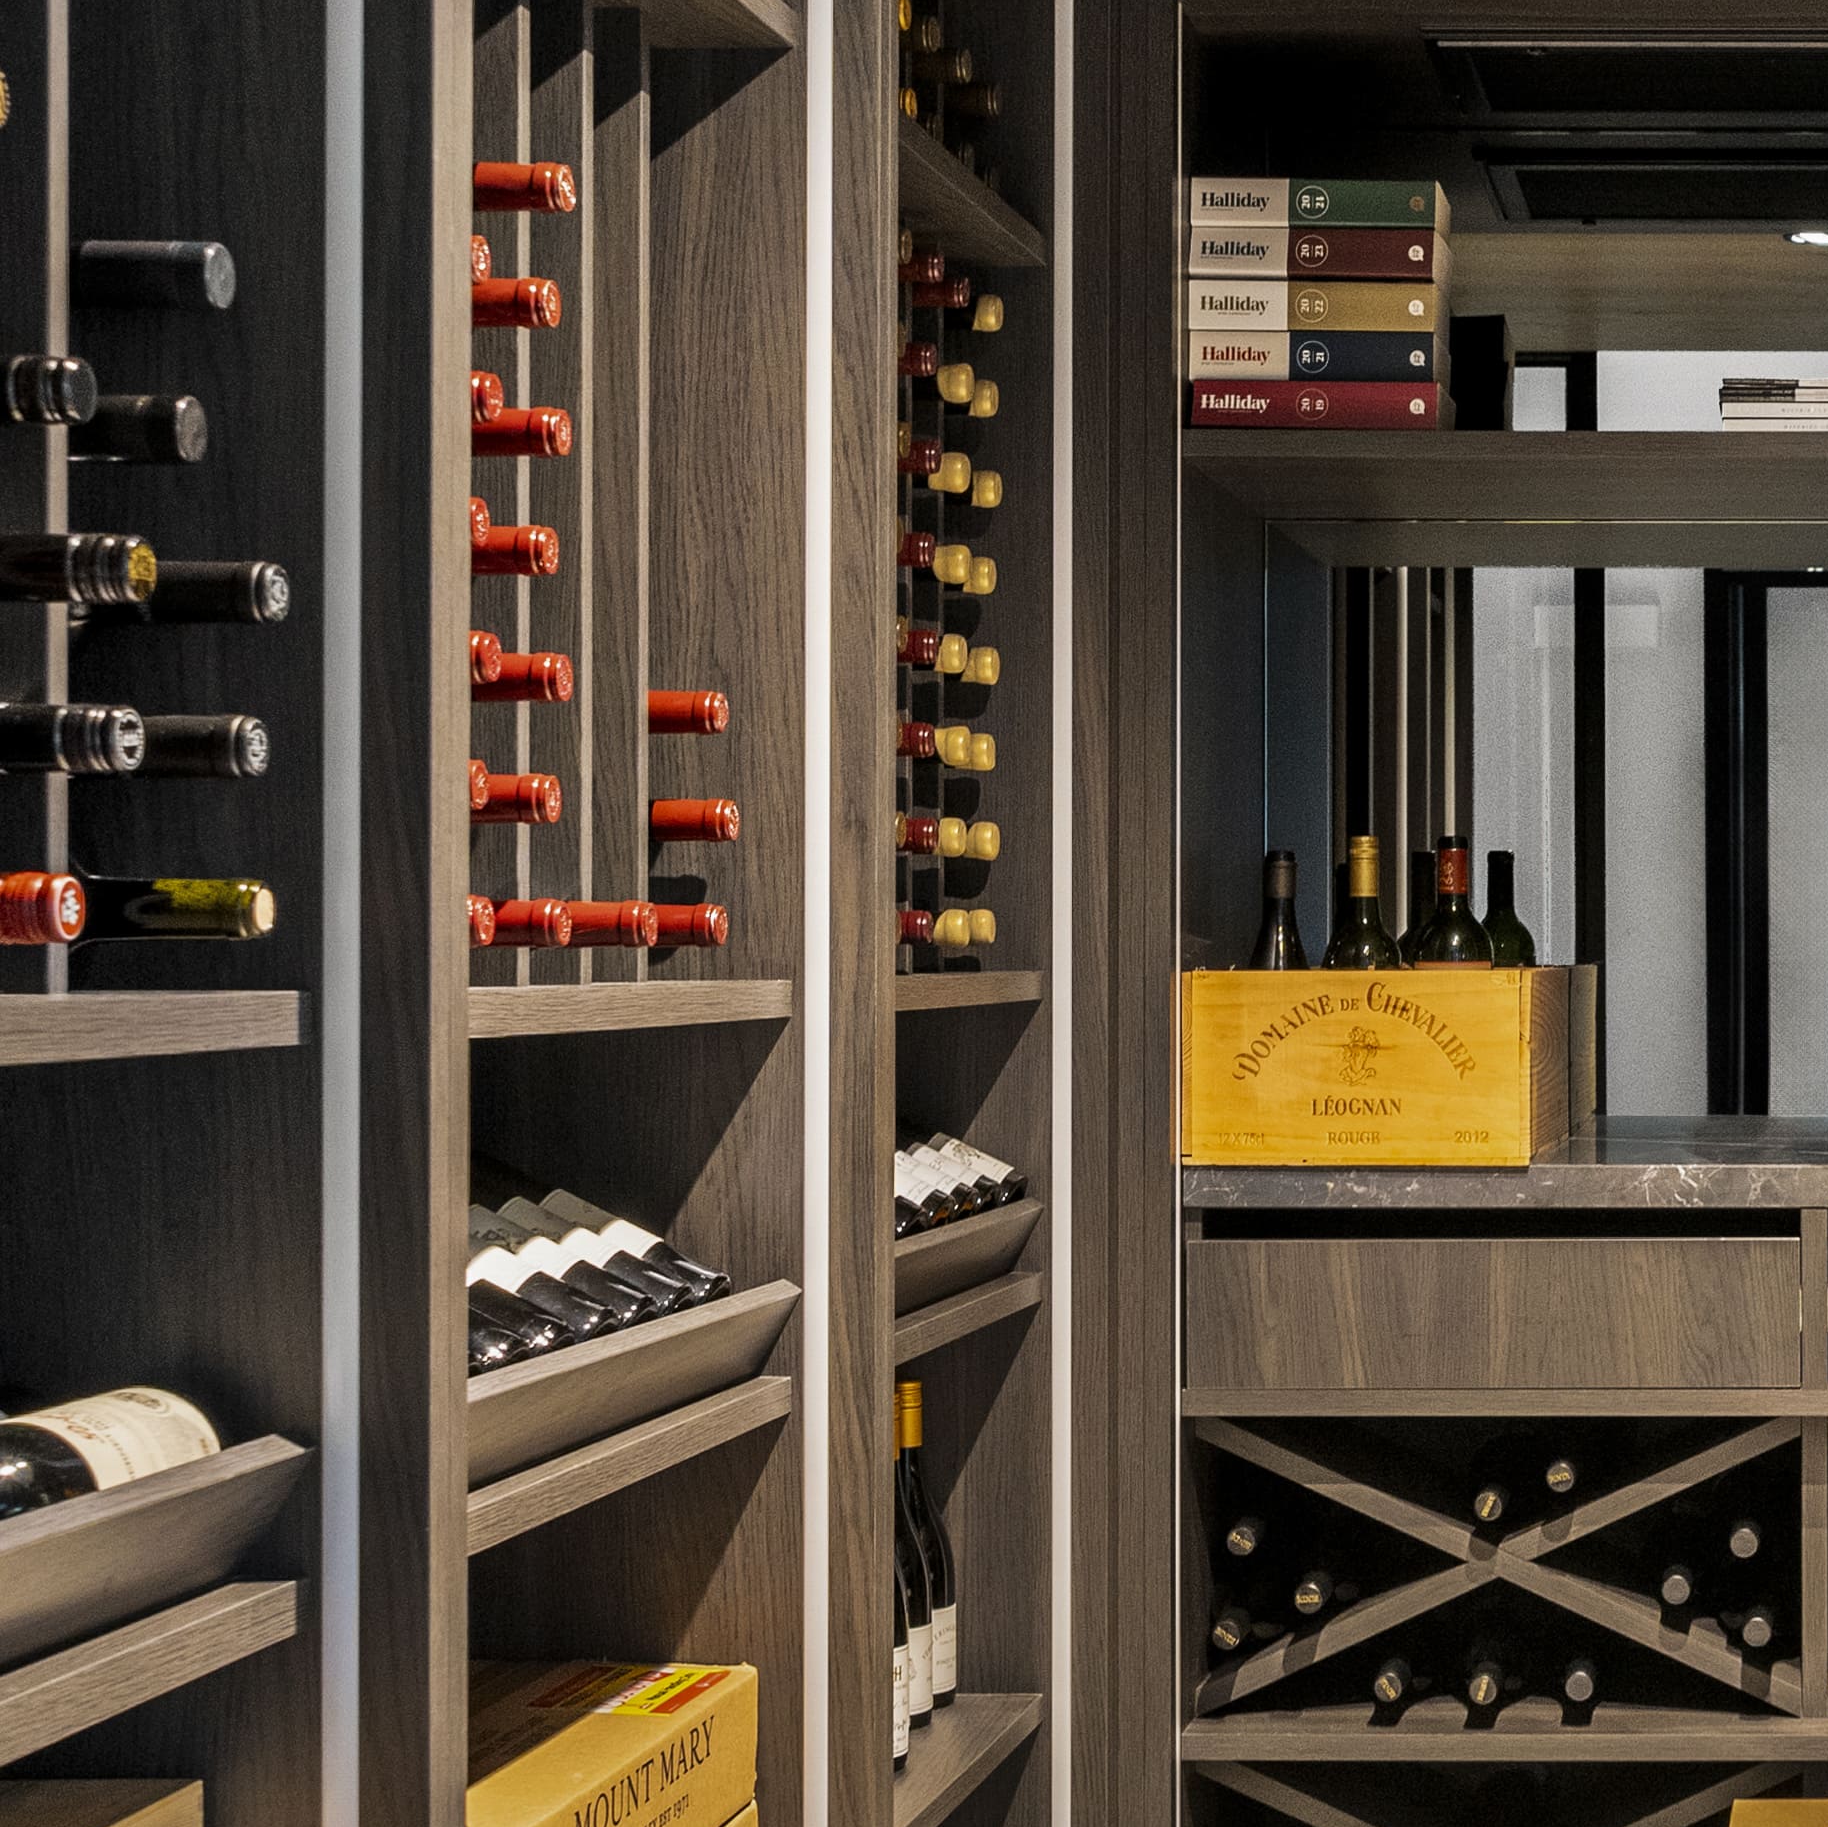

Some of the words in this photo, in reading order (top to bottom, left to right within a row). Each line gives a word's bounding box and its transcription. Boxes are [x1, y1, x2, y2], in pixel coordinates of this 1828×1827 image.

[1200, 192, 1270, 212] Halliday
[1301, 194, 1311, 209] 20
[1200, 241, 1270, 260] Halliday
[1301, 244, 1310, 258] 20
[1314, 244, 1325, 258] 23
[1200, 295, 1269, 315] Halliday
[1301, 298, 1310, 313] 20
[1314, 299, 1325, 313] 22
[1201, 346, 1270, 365] Halliday
[1302, 349, 1311, 364] 20
[1315, 351, 1326, 364] 21
[1200, 394, 1271, 413] Halliday
[1301, 398, 1310, 412] 20
[1314, 400, 1325, 411] 19
[1231, 994, 1334, 1081] DOMAINE
[1339, 998, 1360, 1012] DE
[1365, 981, 1477, 1081] CHEVALIER
[1311, 1095, 1401, 1117] LÉOGNAN
[1327, 1131, 1381, 1146] ROUGE
[1454, 1130, 1490, 1144] 2012
[659, 1714, 715, 1787] MARY
[672, 1793, 690, 1824] 1971
